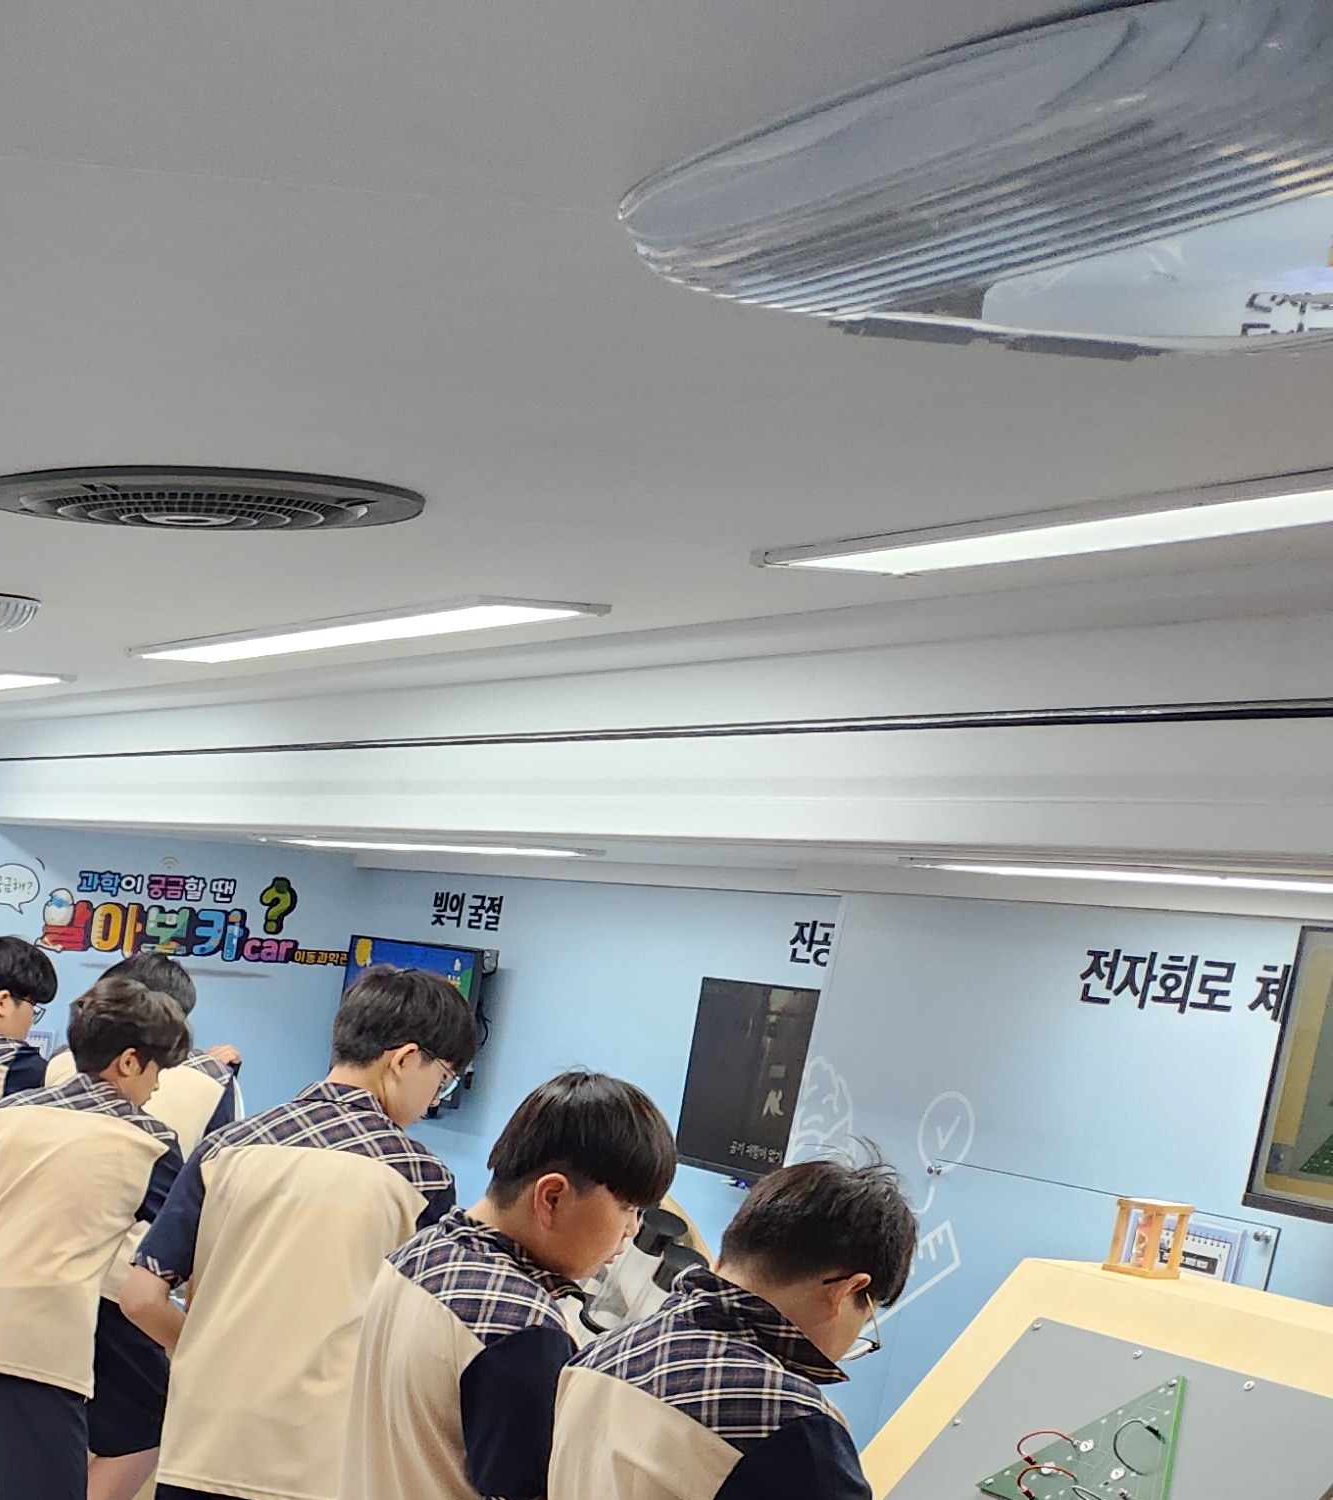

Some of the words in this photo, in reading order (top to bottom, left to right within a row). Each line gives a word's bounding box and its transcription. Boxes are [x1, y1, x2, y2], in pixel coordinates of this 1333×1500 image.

[77, 870, 144, 896] 과학이
[147, 874, 207, 902] 궁금할
[211, 878, 237, 903] 땐
[431, 892, 466, 928] 빛의
[467, 895, 504, 932] 굴절
[243, 937, 298, 963] car
[1080, 948, 1236, 1015] 전자회로
